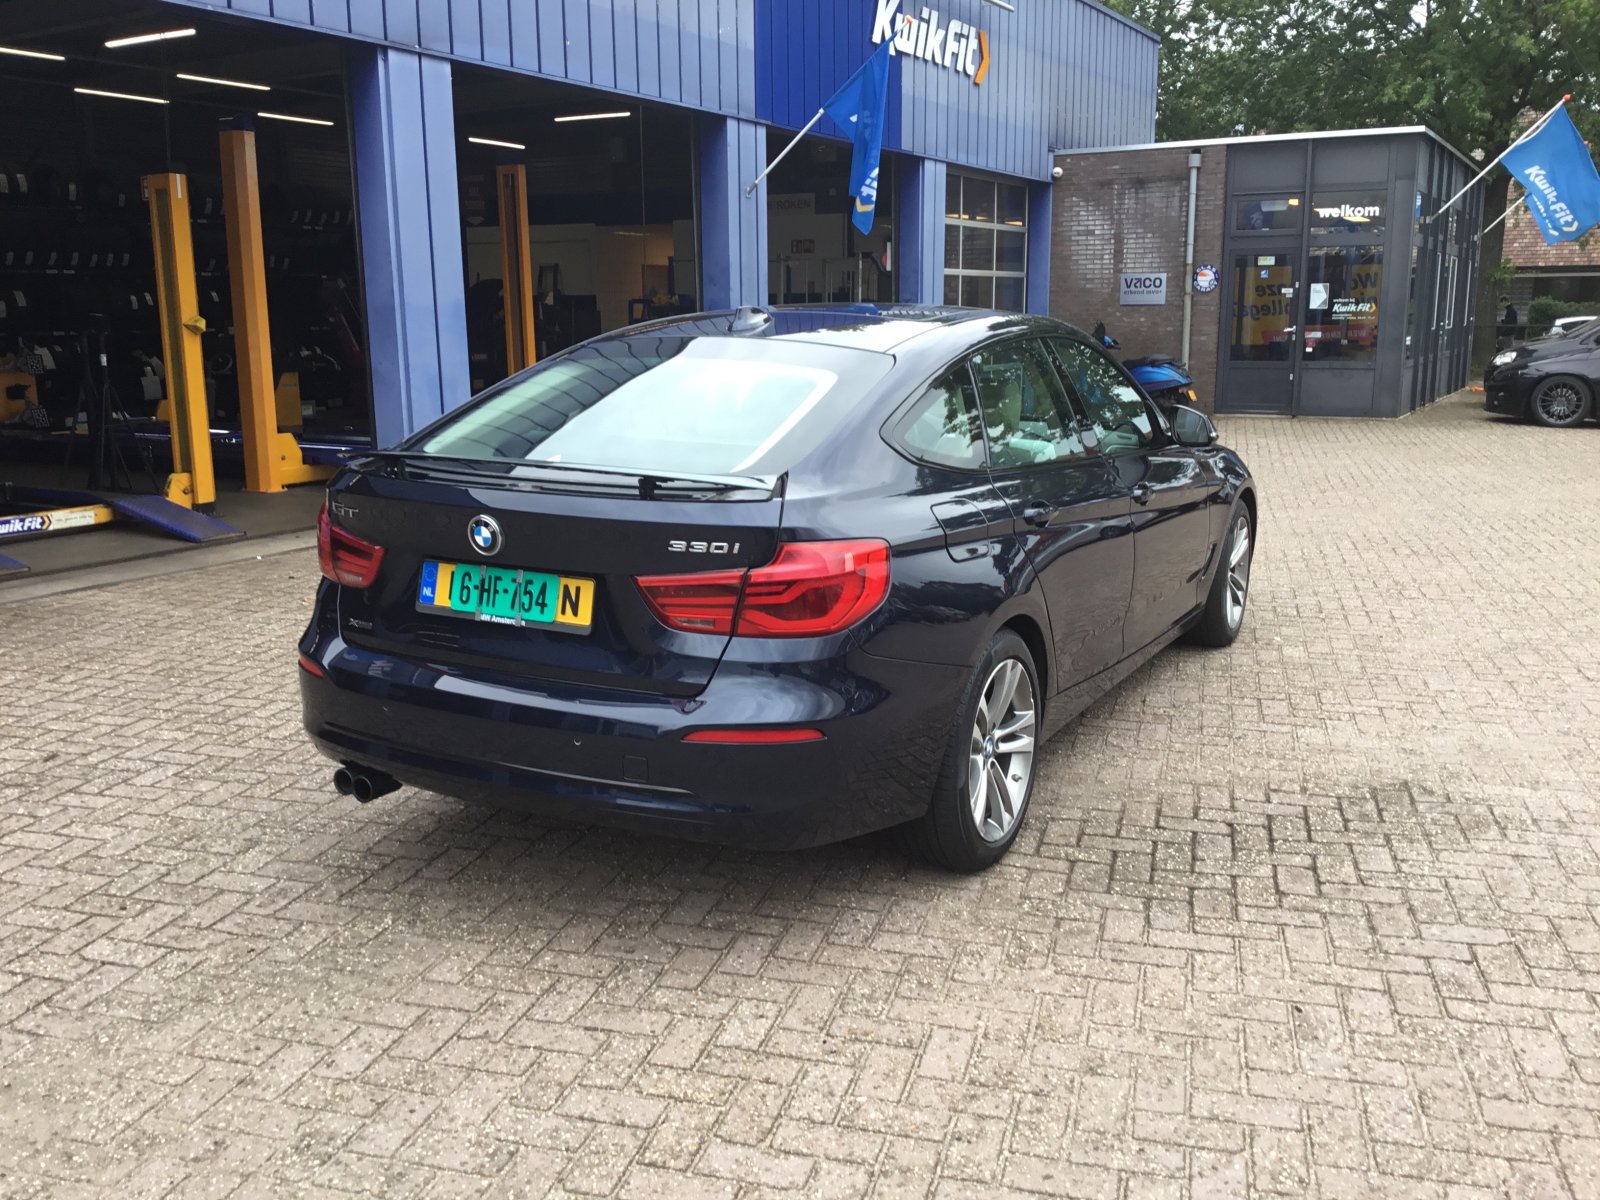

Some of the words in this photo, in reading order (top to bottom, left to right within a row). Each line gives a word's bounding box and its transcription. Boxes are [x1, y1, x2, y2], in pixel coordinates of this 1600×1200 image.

[1320, 204, 1380, 218] welkom
[332, 500, 359, 518] GT
[0, 516, 42, 534] wikFit
[422, 586, 434, 599] NL
[560, 584, 581, 618] N
